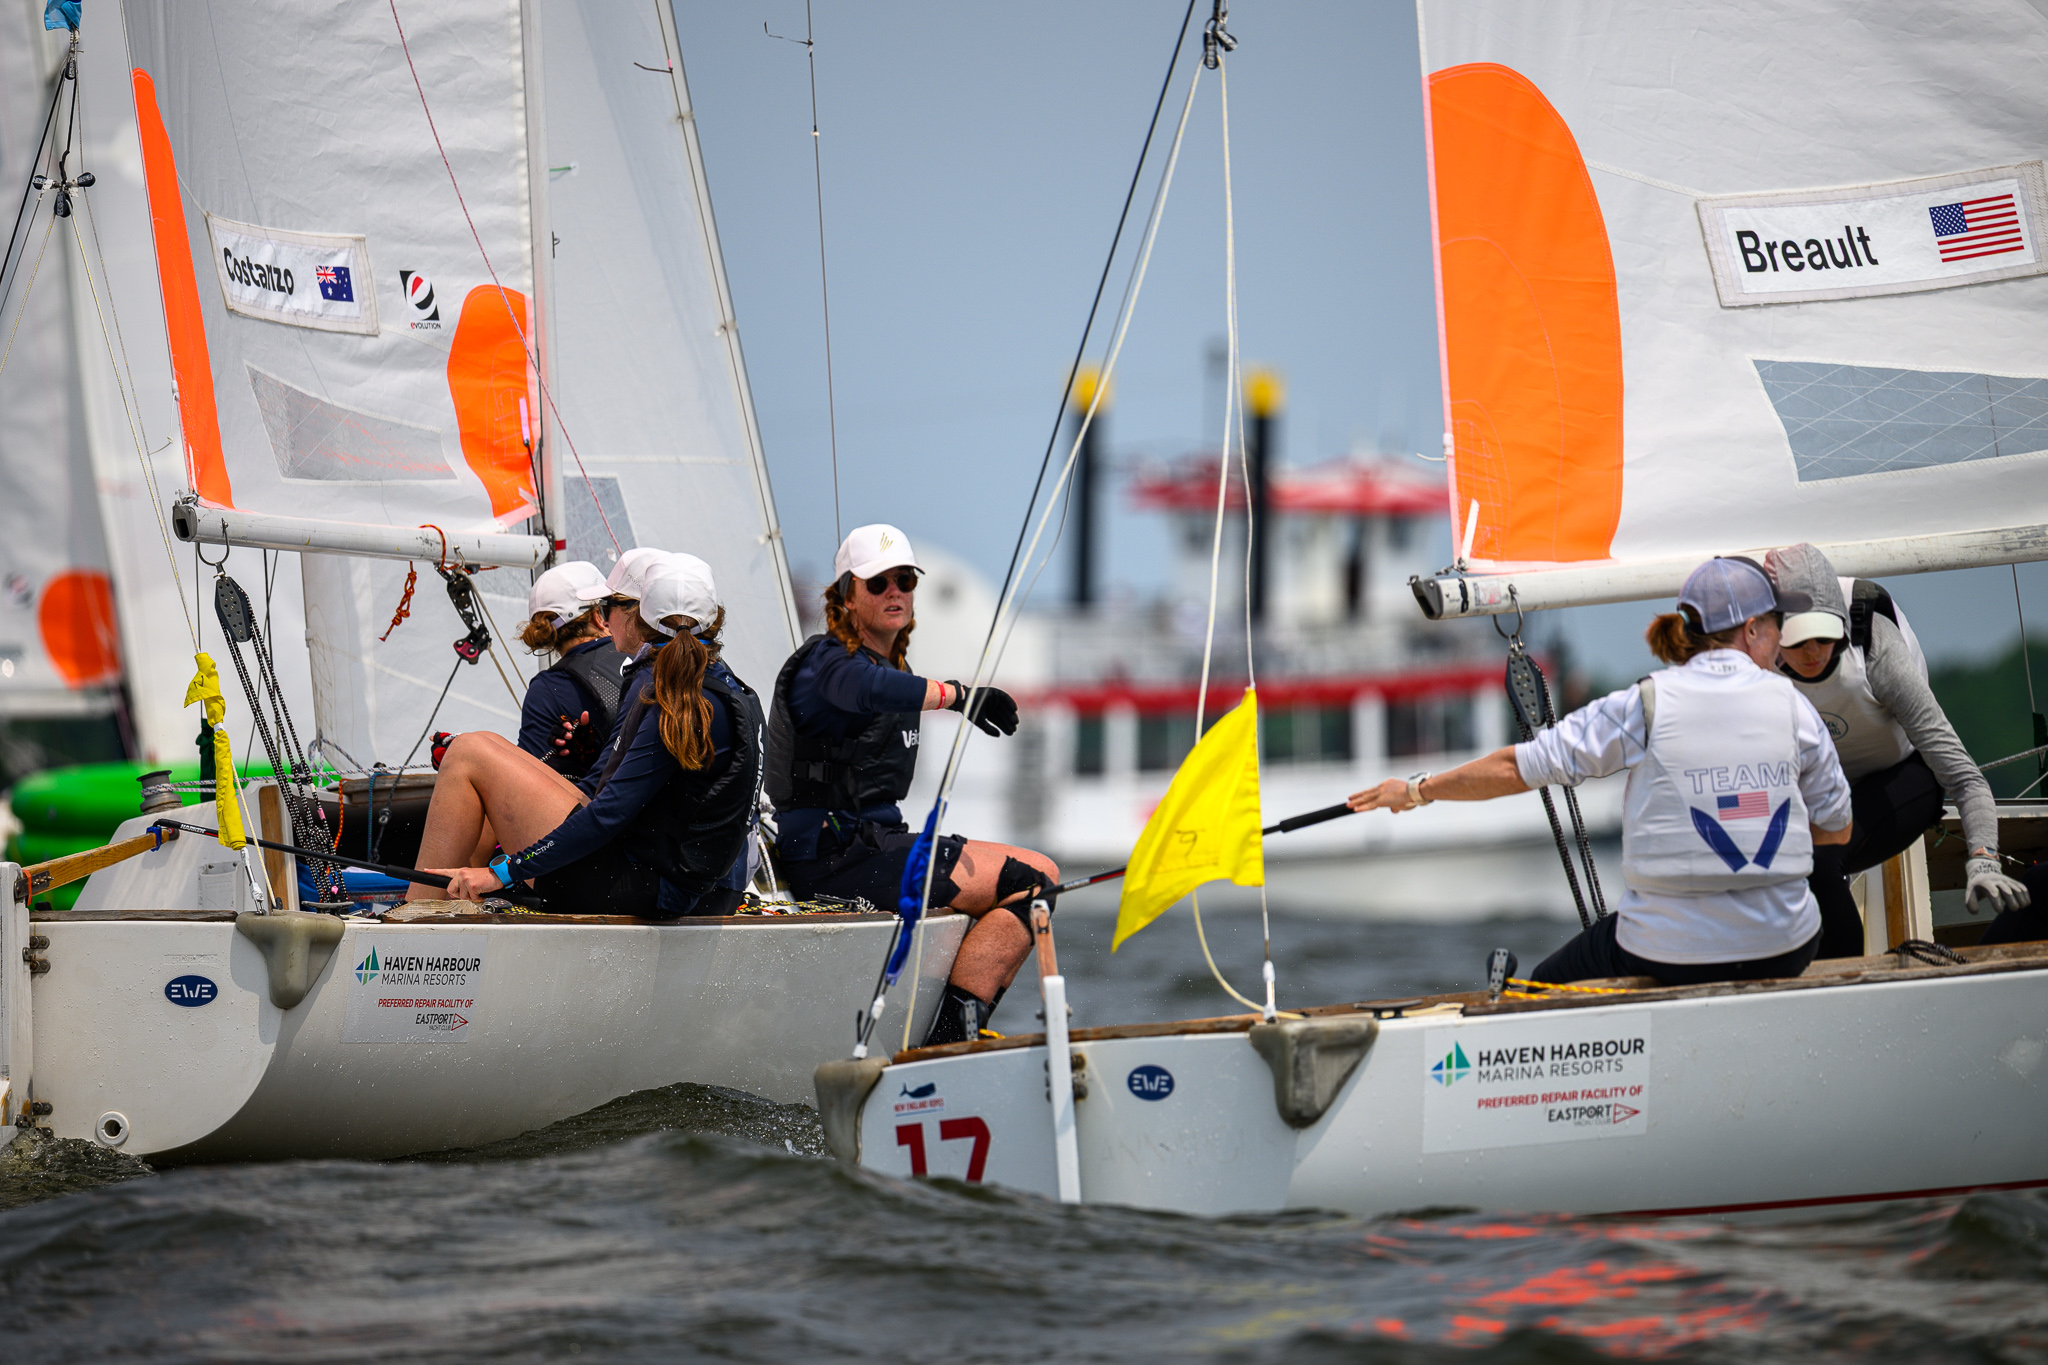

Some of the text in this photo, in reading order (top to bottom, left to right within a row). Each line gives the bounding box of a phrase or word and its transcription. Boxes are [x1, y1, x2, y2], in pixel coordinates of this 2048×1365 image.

[1735, 225, 1879, 273] Breault
[223, 247, 295, 296] Costanzo
[1684, 760, 1790, 795] TEAM
[383, 956, 481, 972] HAVEN HARBOUR
[381, 973, 466, 985] MARINA RESORTS
[171, 984, 211, 998] EWE
[378, 998, 474, 1008] PREFERRED REPAIR FACILITY OF
[415, 1013, 454, 1025] EASTPORT
[1478, 1038, 1645, 1067] HAVEN HARBOUR
[1477, 1058, 1624, 1084] MARINA RESORTS
[1132, 1073, 1170, 1092] EWE
[1477, 1085, 1643, 1109] PREFERRED REPAIR FACILITY OF
[1548, 1104, 1612, 1122] EASTPORT
[895, 1116, 991, 1183] 17
